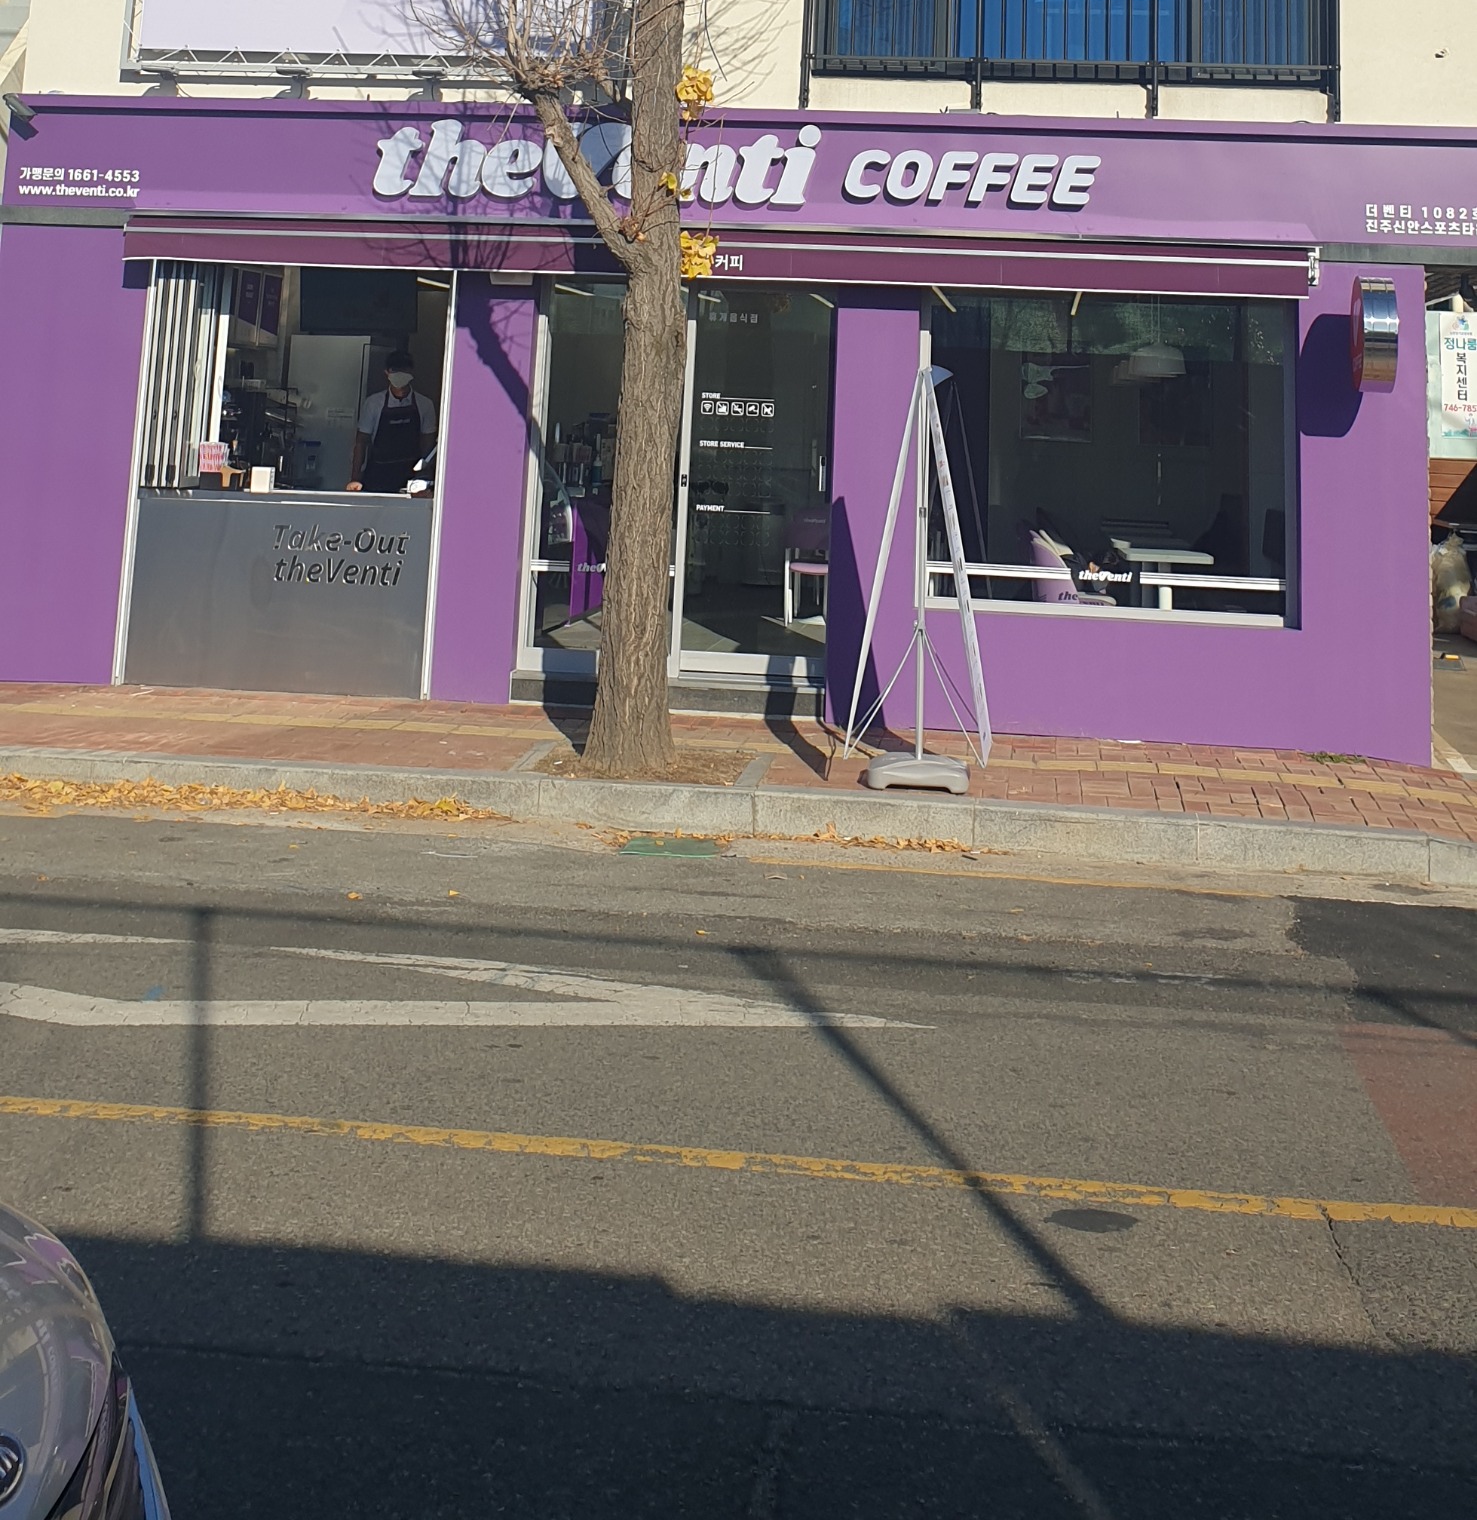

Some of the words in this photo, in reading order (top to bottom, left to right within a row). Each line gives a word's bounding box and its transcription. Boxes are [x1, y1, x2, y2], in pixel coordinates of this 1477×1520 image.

[19, 166, 65, 181] 가맹문의
[68, 168, 140, 182] 1661-4553
[843, 149, 1102, 206] COFFEE
[18, 183, 141, 198] www.theventi.co.kr
[1365, 219, 1477, 236] 진주신안스포츠타
[714, 253, 744, 271] 커피
[1455, 352, 1469, 402] 복지센터
[701, 391, 721, 399] STORE
[699, 440, 719, 448] STORE
[720, 440, 745, 449] SERVICE
[696, 504, 725, 512] PAYMENT
[272, 523, 411, 555] Take-Out
[273, 554, 405, 588] theVenti
[1078, 569, 1133, 583] theVenti
